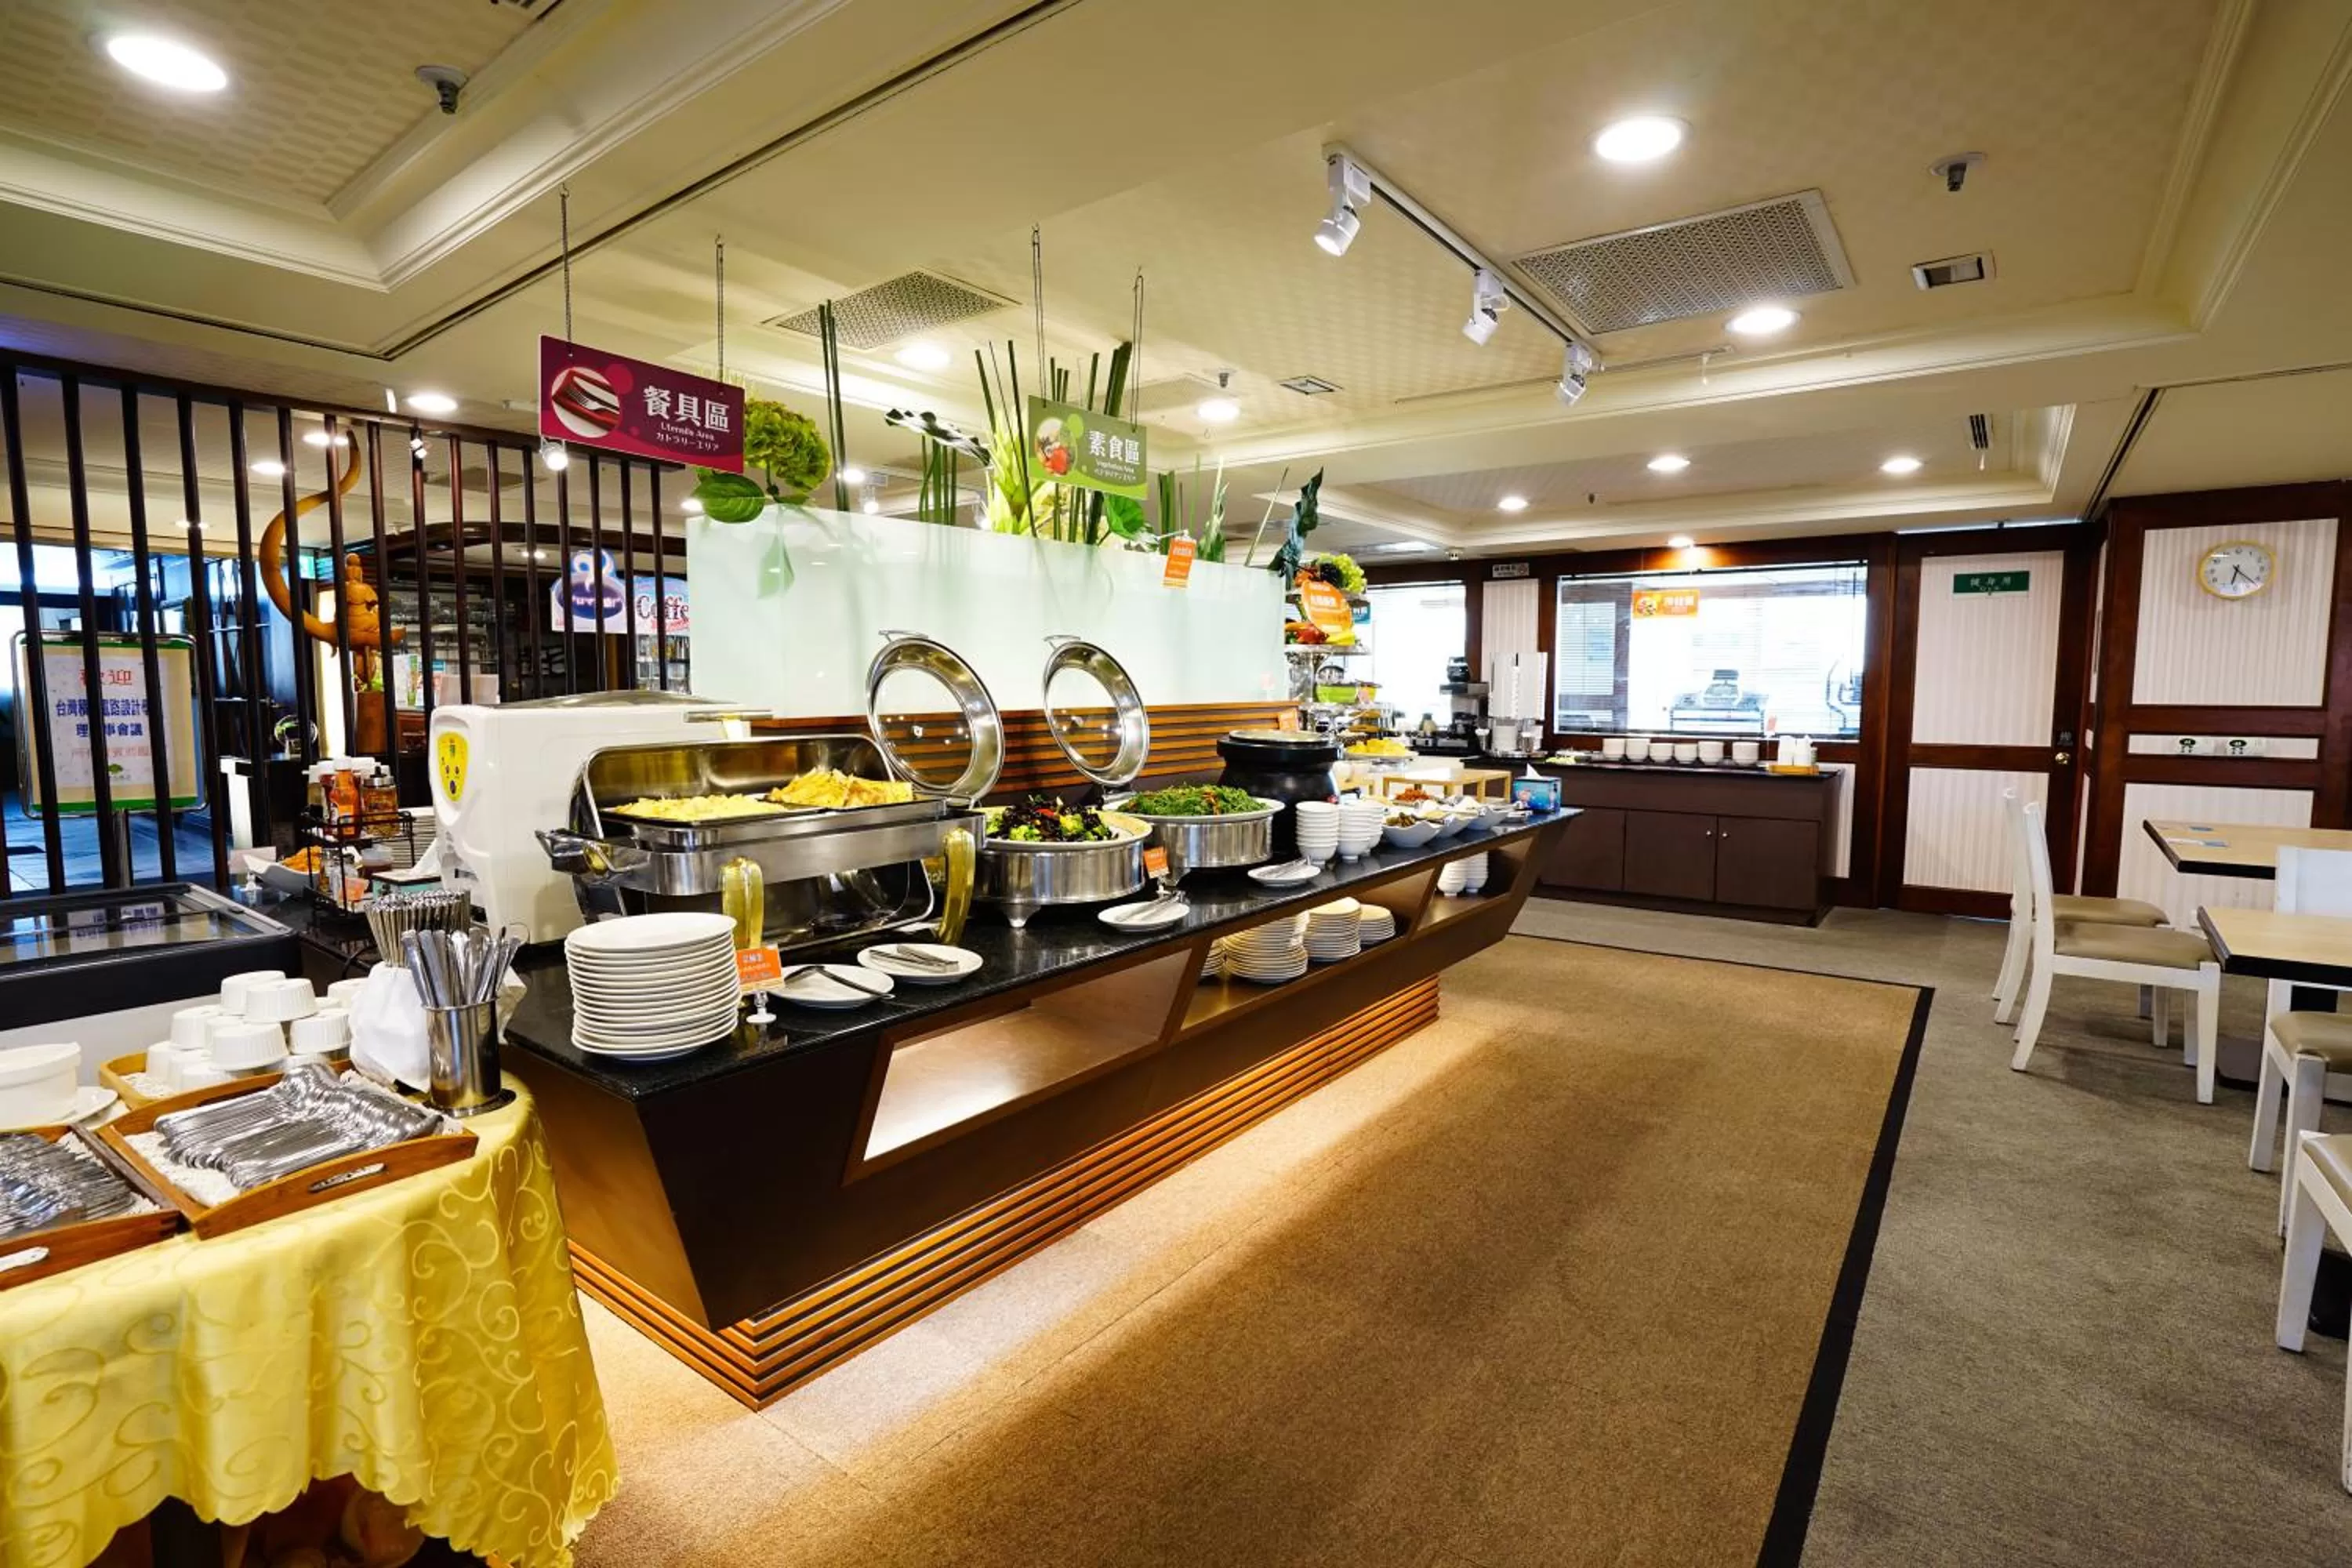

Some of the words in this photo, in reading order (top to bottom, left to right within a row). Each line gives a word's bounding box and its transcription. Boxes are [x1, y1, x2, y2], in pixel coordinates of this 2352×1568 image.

[643, 385, 730, 433] 餐具區
[1087, 430, 1140, 465] 素食區
[76, 722, 143, 738] 理事會議
